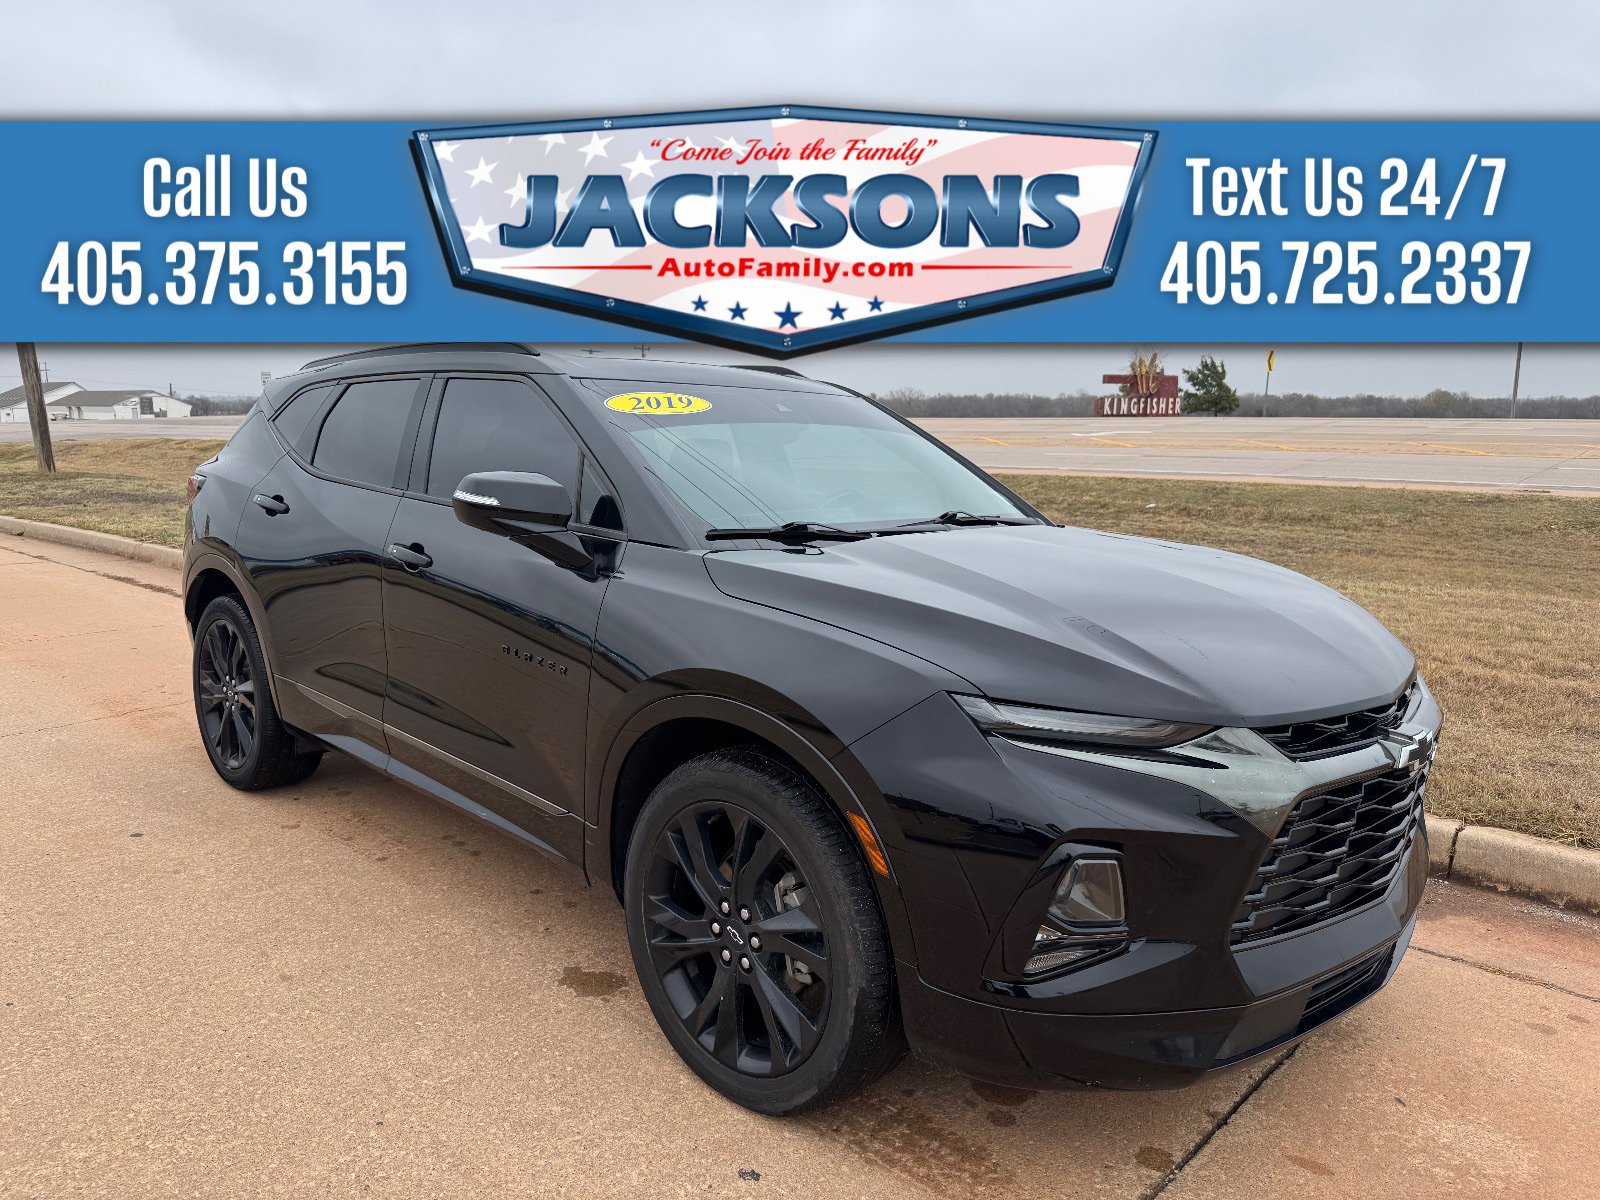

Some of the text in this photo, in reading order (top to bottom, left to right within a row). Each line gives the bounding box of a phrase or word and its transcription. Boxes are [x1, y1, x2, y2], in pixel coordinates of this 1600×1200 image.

[628, 396, 693, 411] 2019
[1103, 397, 1181, 415] KINGFISHER
[501, 643, 569, 677] BLAZER
